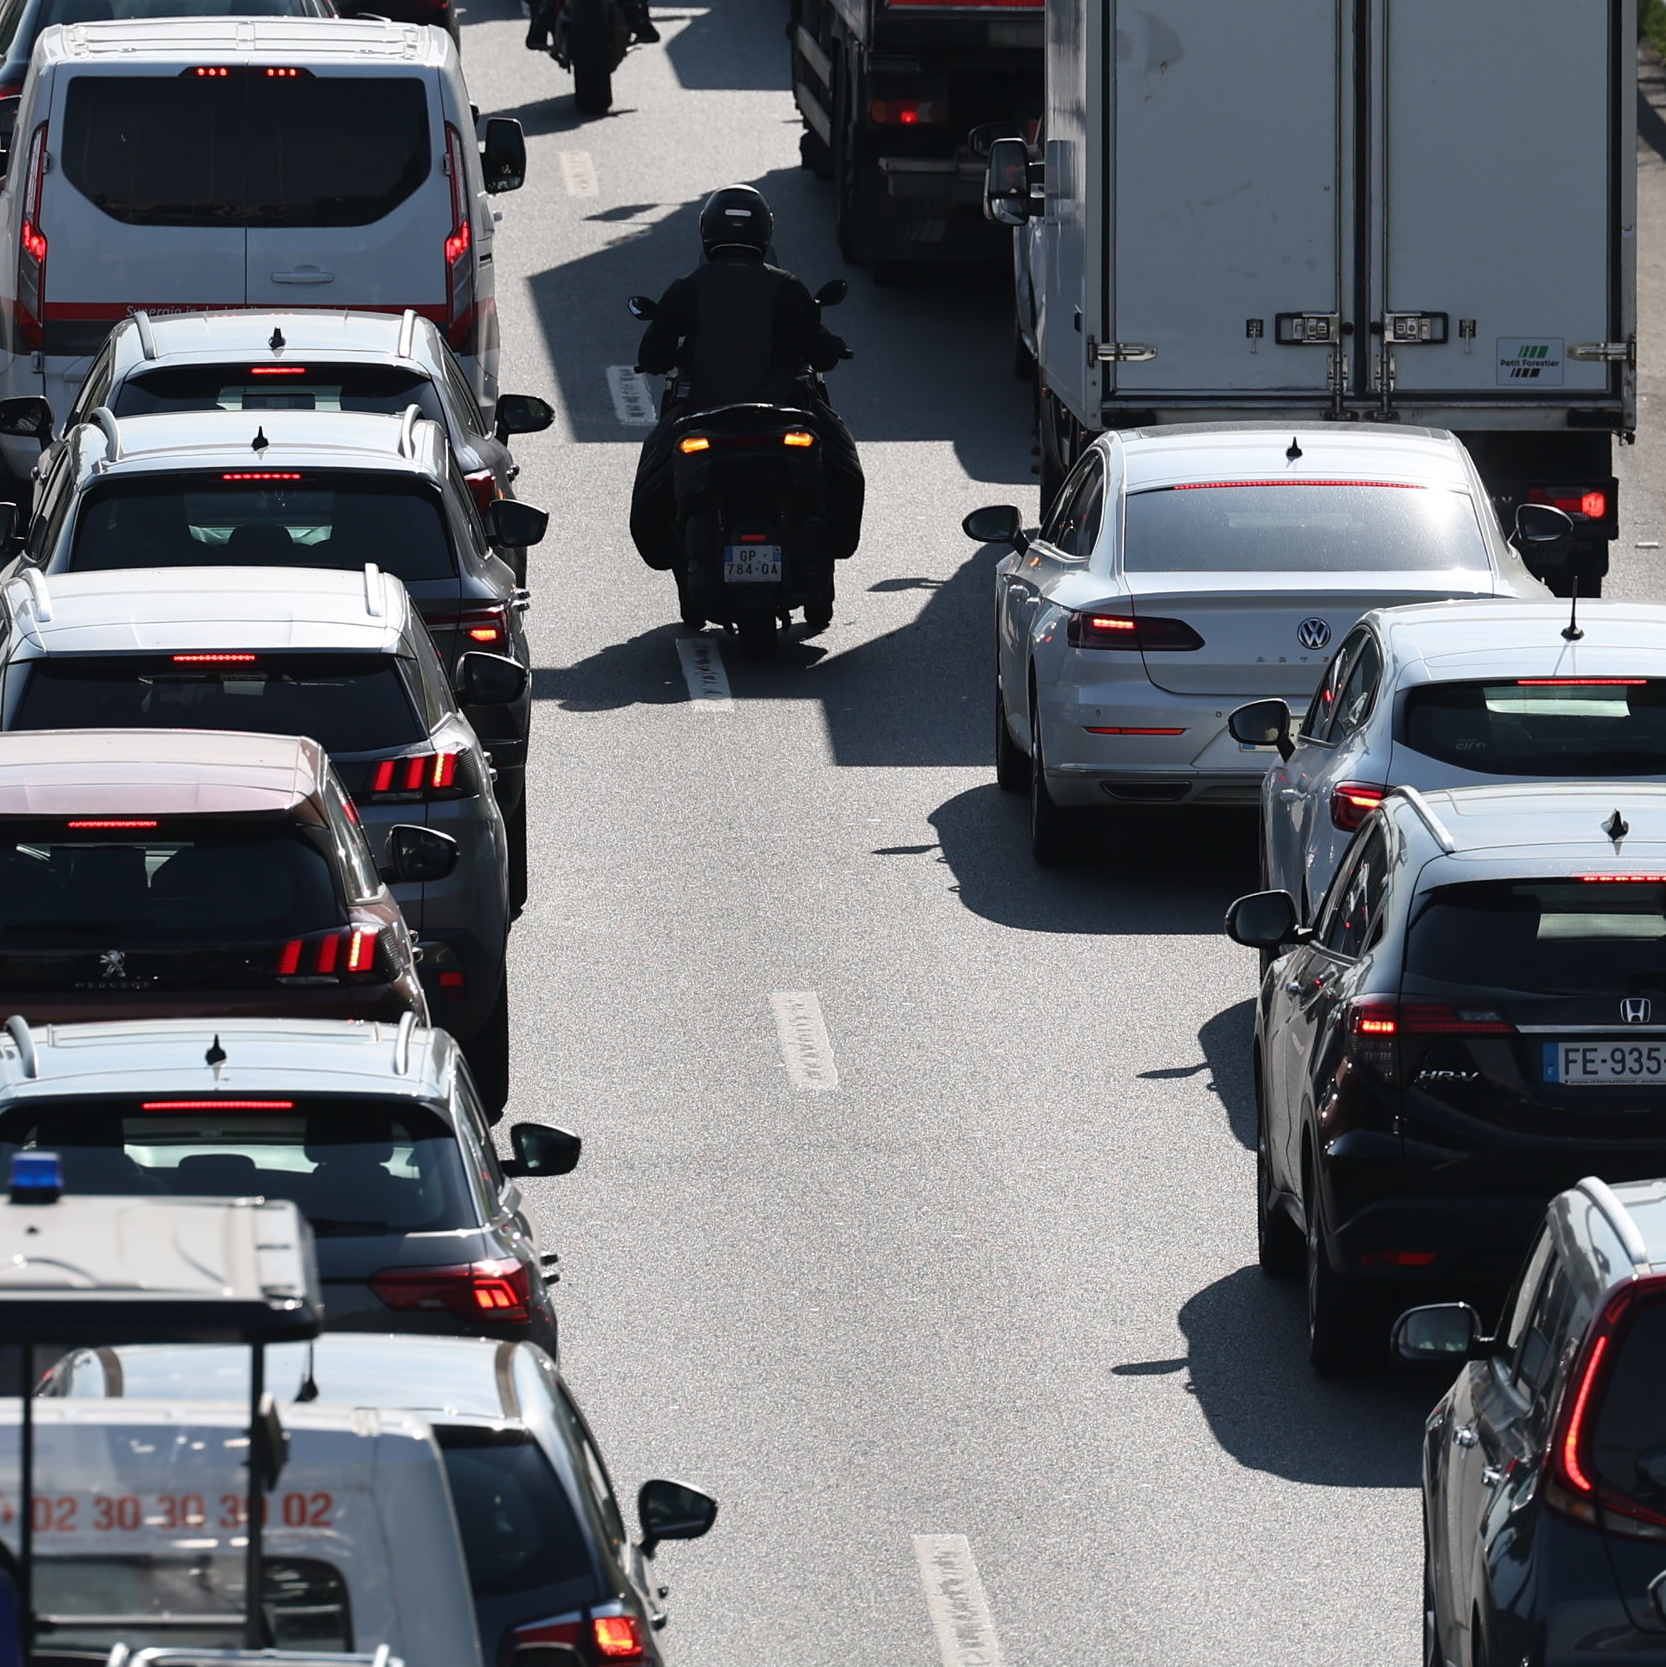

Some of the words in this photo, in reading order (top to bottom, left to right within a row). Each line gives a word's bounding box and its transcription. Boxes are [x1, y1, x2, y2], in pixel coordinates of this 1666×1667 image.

[1500, 359, 1521, 367] Petit
[1522, 359, 1560, 367] Forestier
[1419, 1069, 1480, 1082] HR-V
[30, 1496, 78, 1532] 02
[93, 1495, 141, 1532] 30
[156, 1494, 204, 1531] 30
[283, 1491, 333, 1529] 02
